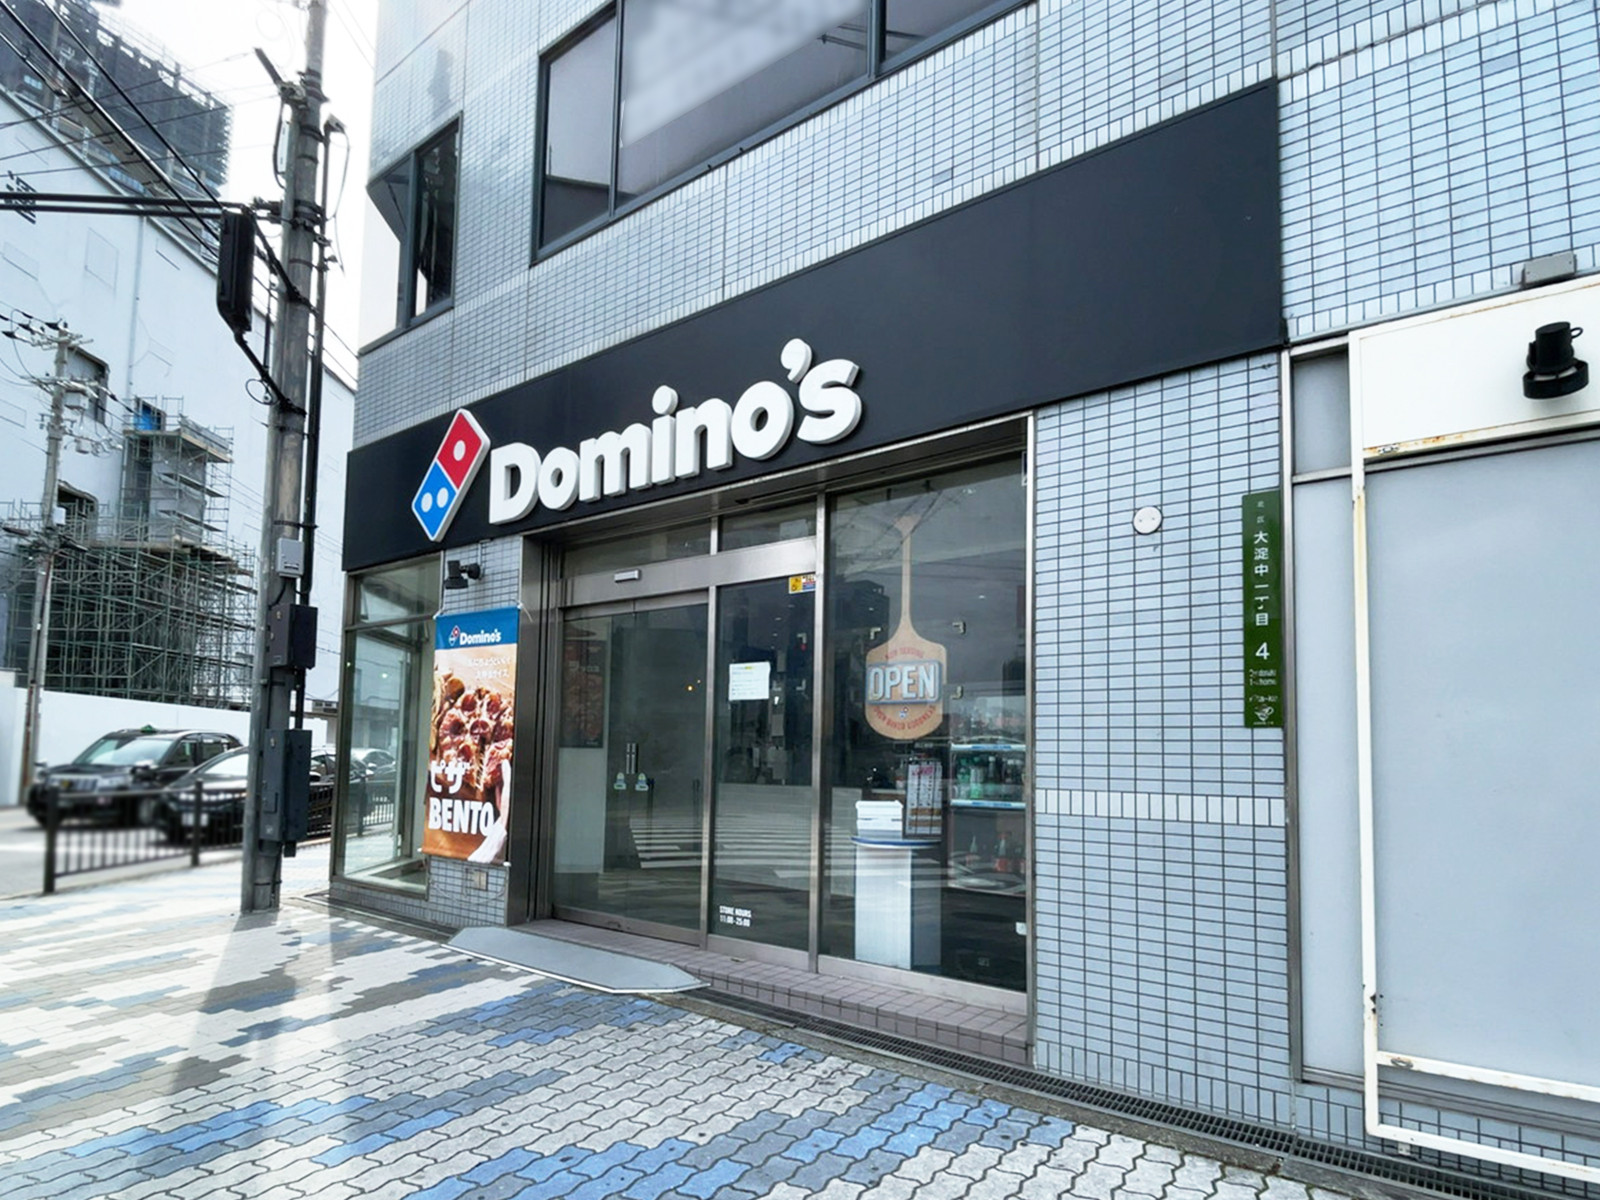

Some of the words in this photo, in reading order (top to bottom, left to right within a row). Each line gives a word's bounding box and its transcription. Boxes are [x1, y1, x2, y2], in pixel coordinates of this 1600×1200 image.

[489, 338, 862, 525] Domino's
[1253, 530, 1270, 627] 大淀中一丁目
[459, 628, 502, 646] Domino's
[1255, 641, 1270, 660] 4
[869, 664, 936, 701] OPEN
[428, 796, 496, 837] BENTO
